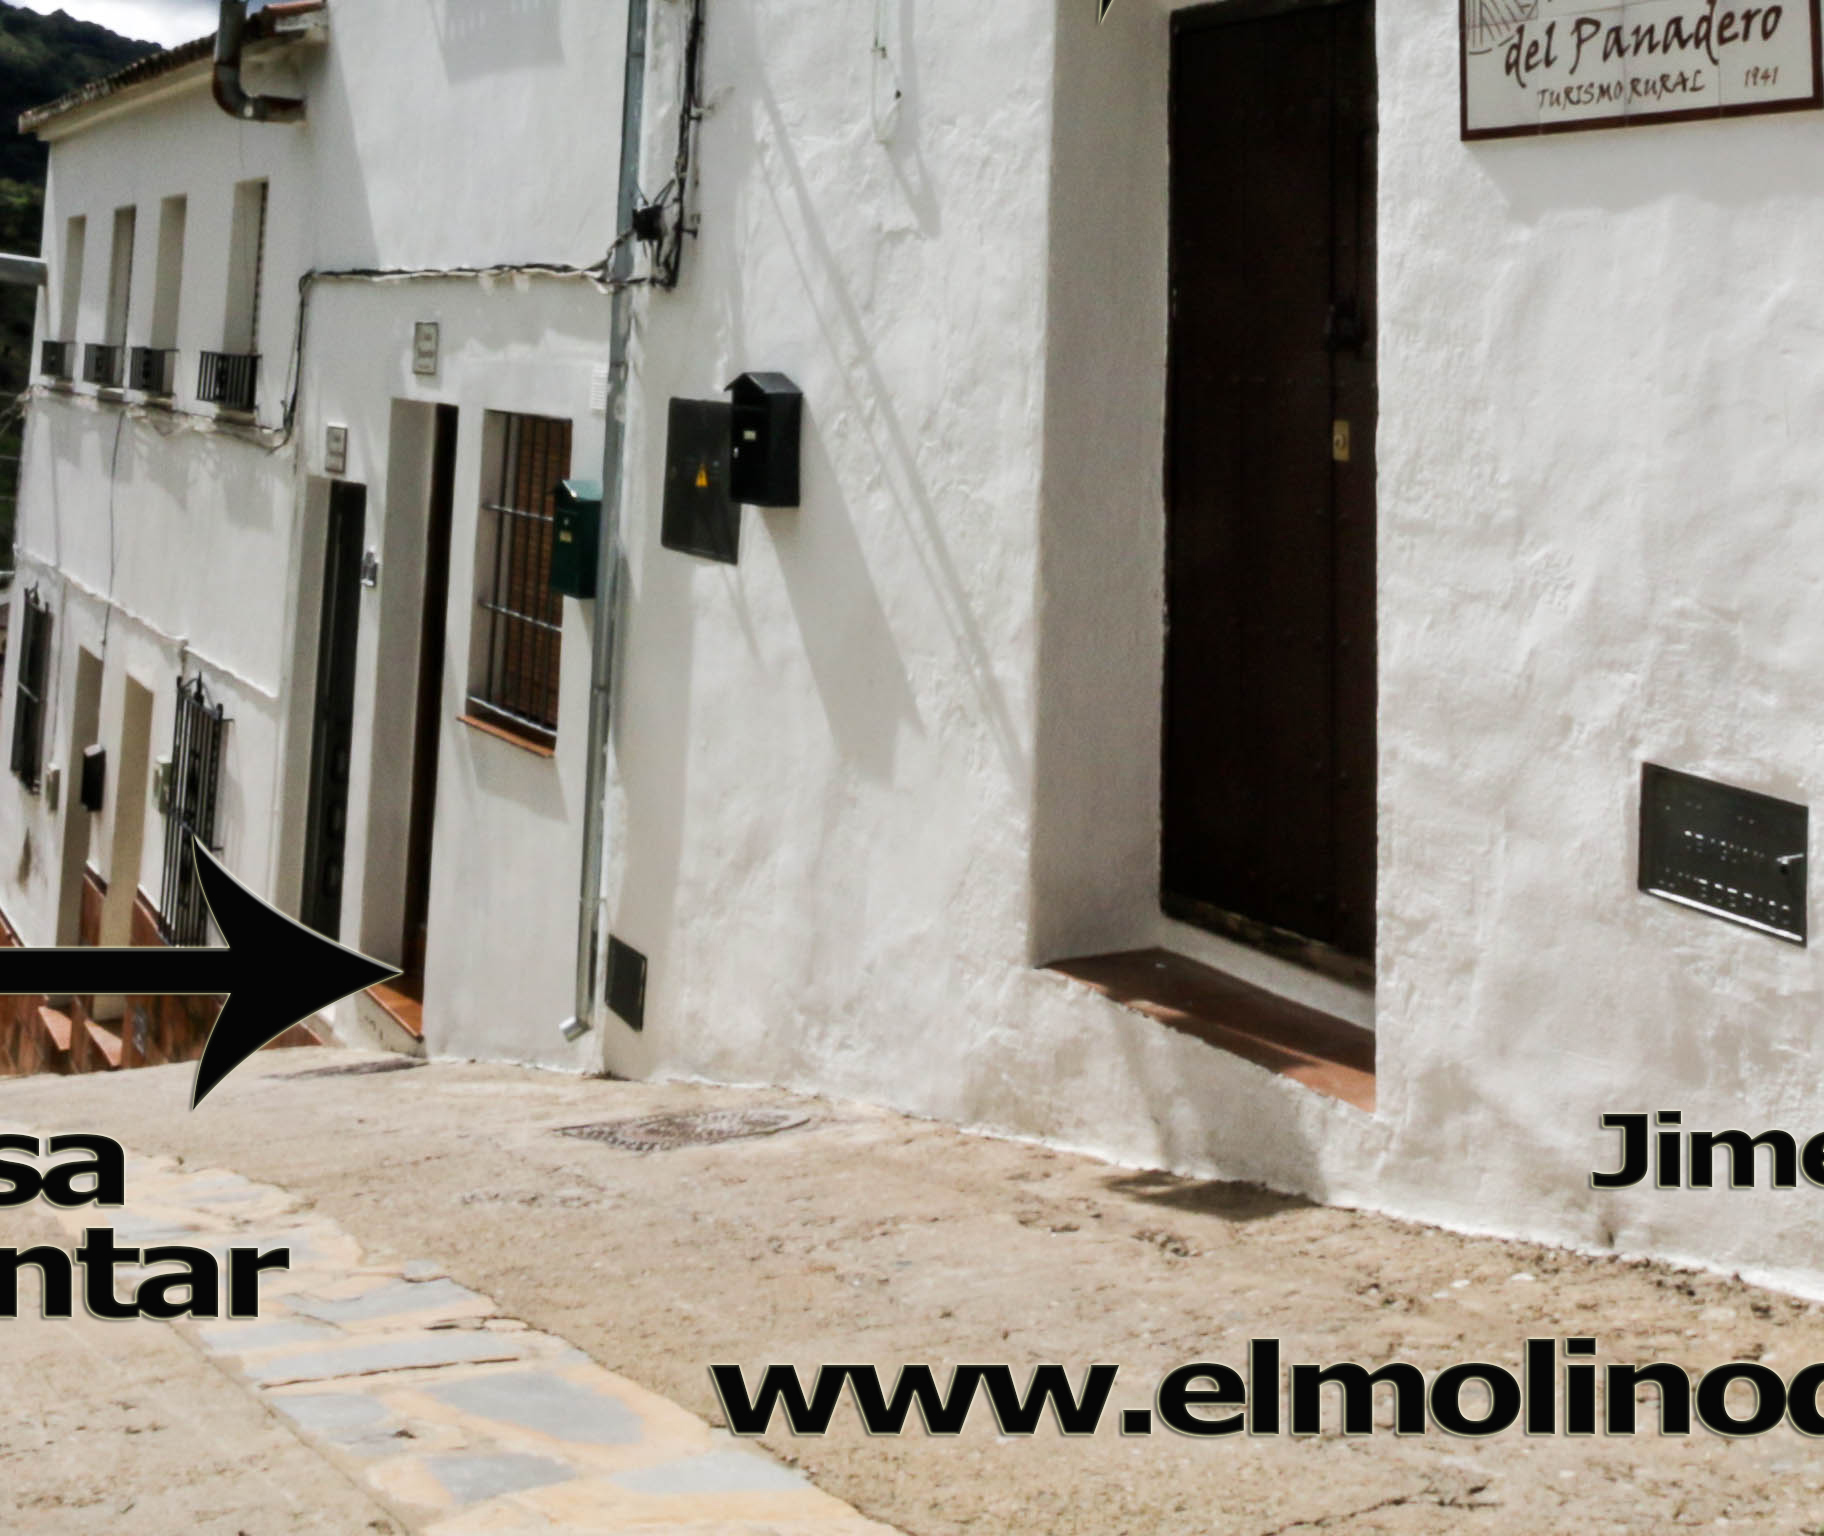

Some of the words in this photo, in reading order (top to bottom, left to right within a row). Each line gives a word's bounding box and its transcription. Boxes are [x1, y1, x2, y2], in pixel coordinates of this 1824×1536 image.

[1504, 20, 1559, 89] del
[1537, 79, 1625, 110] TURISMO
[1628, 68, 1706, 105] RURAL
